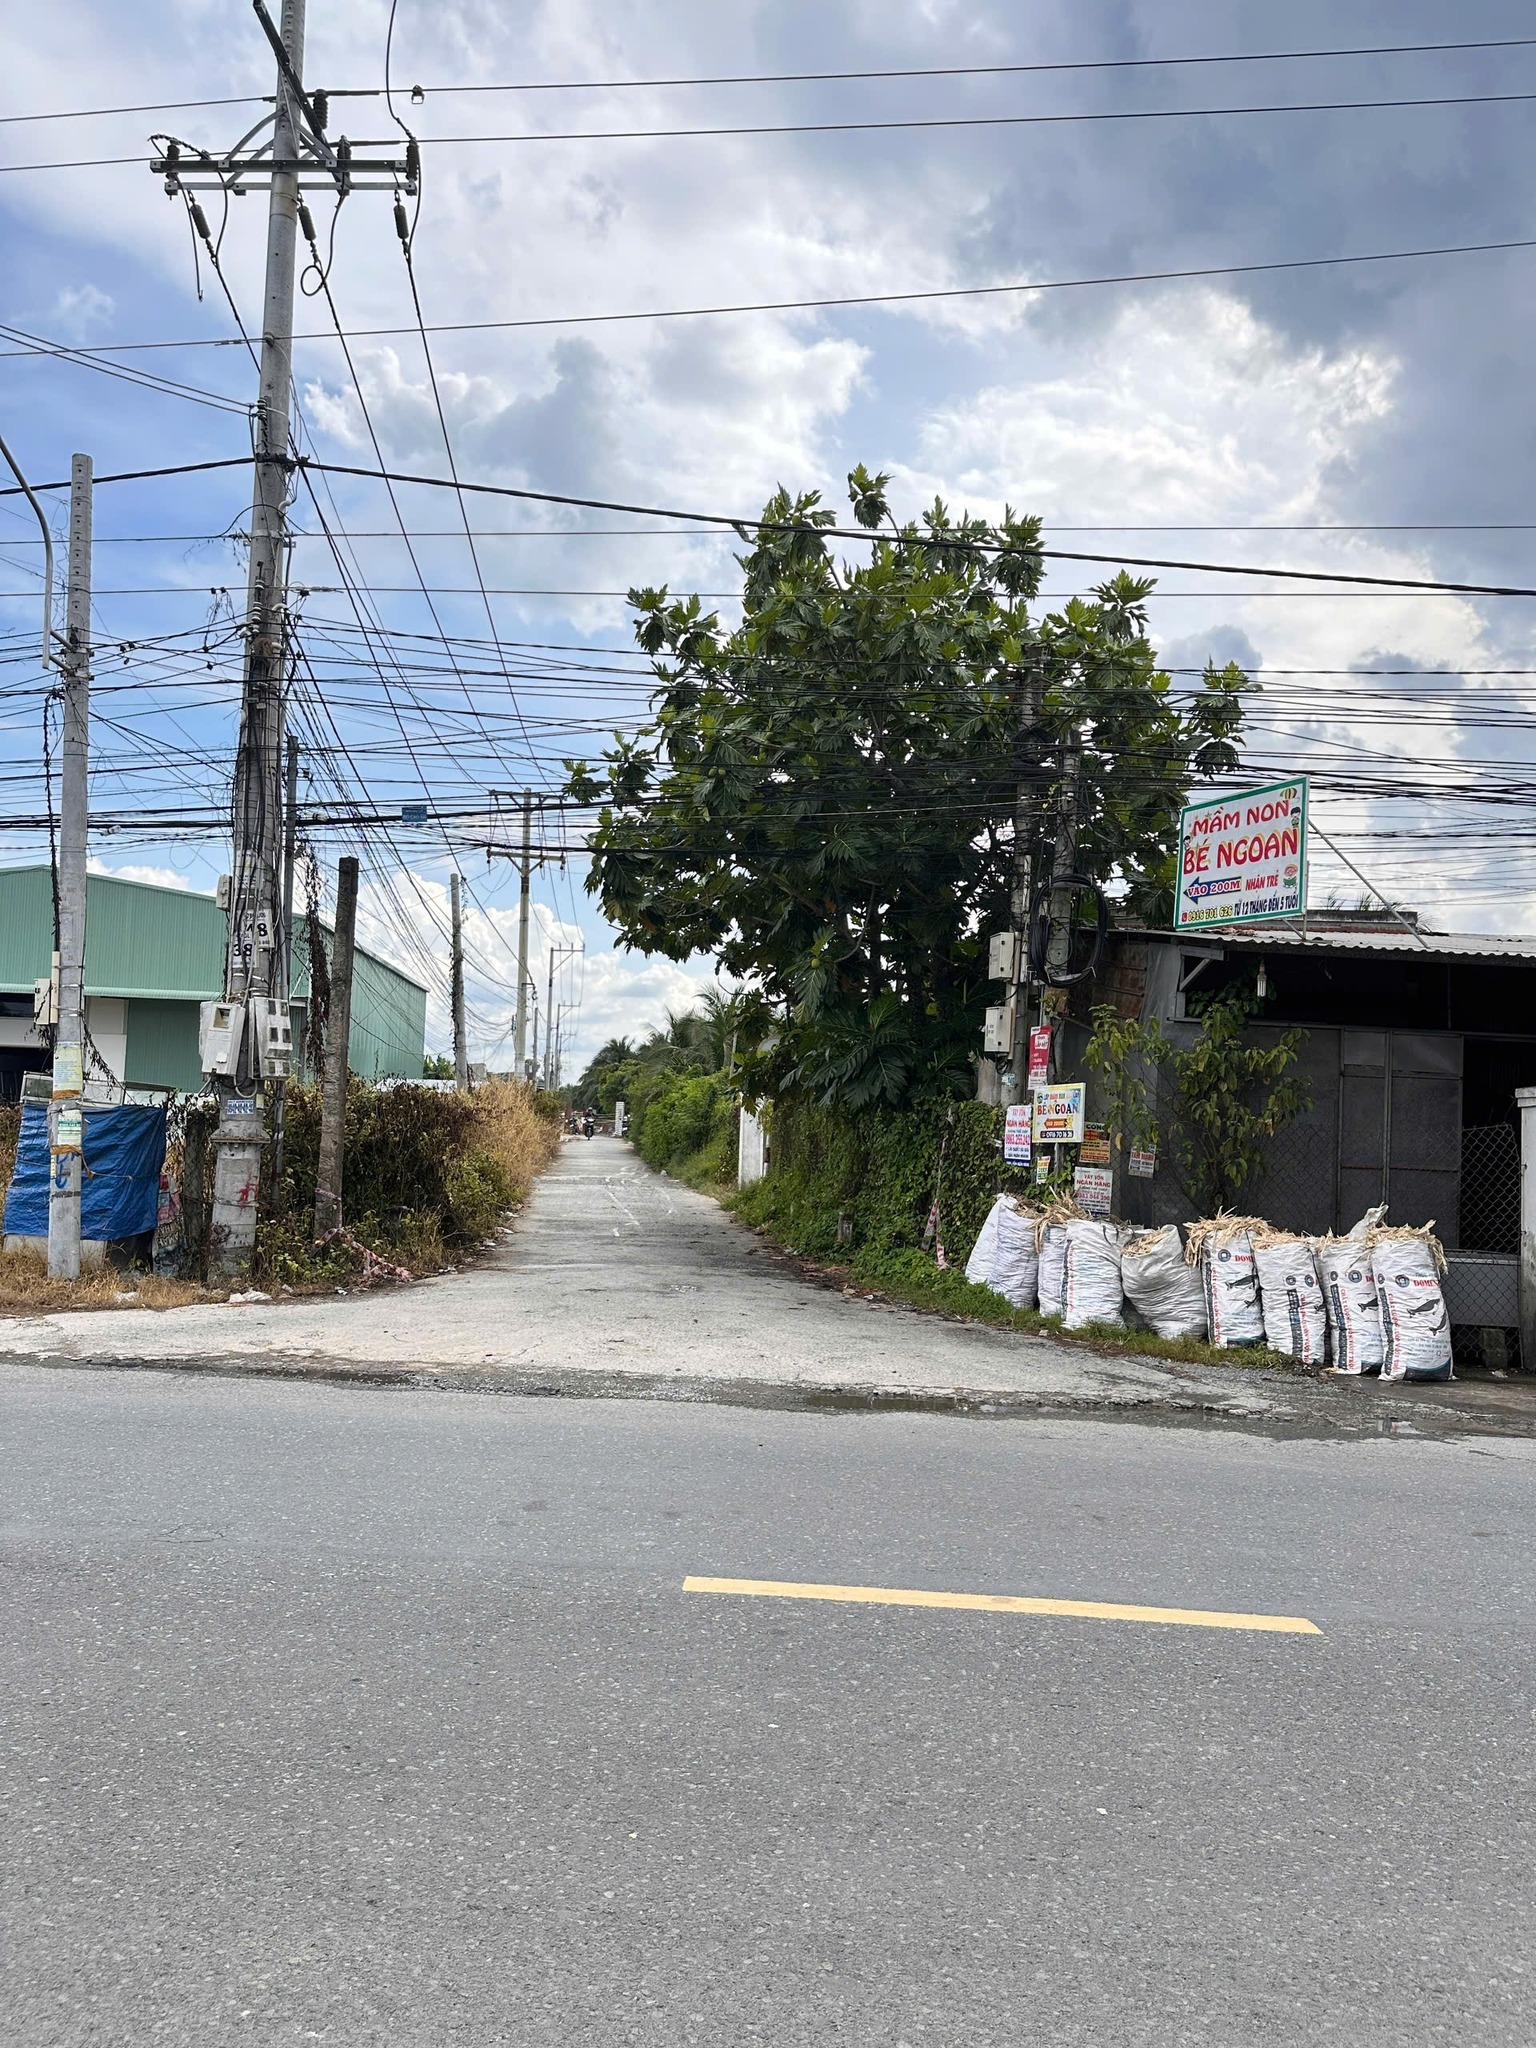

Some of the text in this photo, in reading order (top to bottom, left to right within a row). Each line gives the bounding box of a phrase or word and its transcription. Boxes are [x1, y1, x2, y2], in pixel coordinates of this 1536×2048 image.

[1193, 800, 1289, 836] MẦM NON
[1183, 829, 1297, 875] BÉ NGOAN
[1267, 870, 1279, 888] TRẺ
[1187, 881, 1241, 897] VÀO 200M
[1242, 901, 1249, 915] 12
[1280, 897, 1284, 910] 5
[1048, 1103, 1078, 1115] NGOAN
